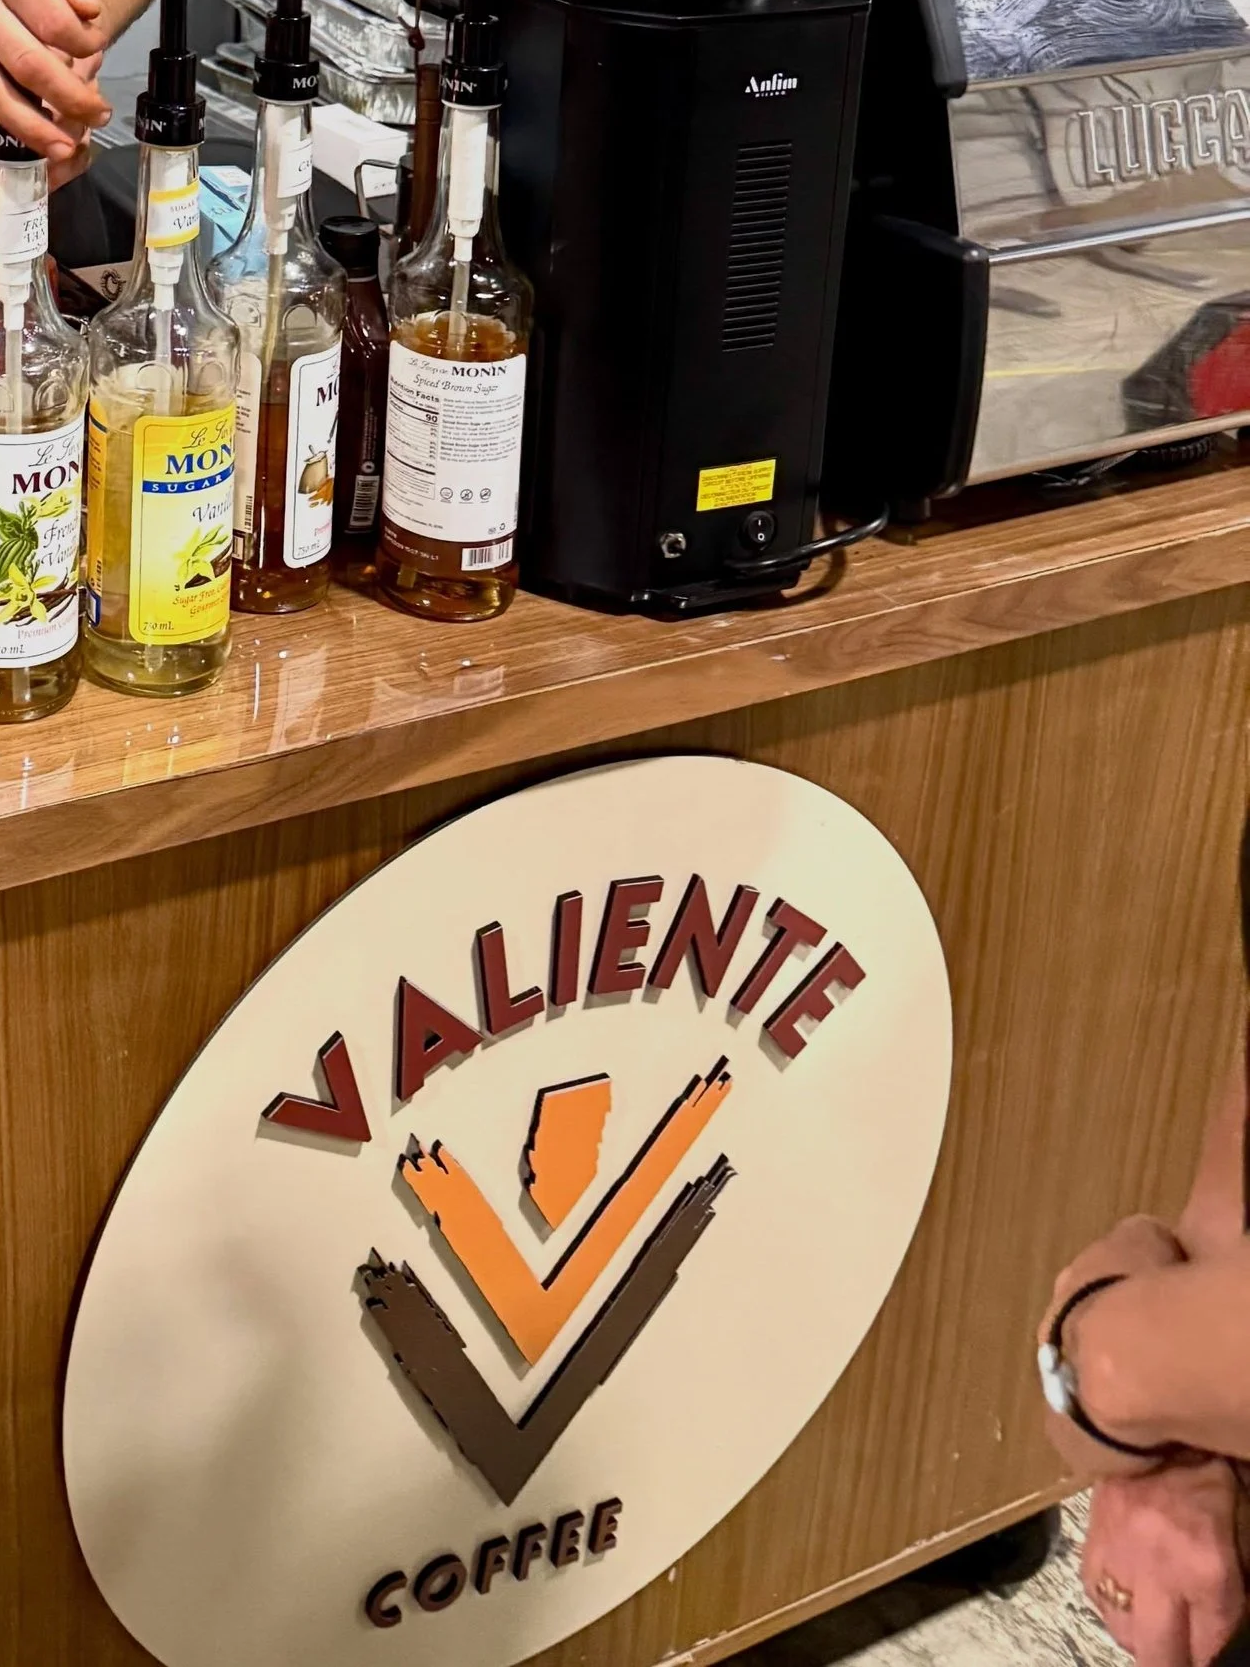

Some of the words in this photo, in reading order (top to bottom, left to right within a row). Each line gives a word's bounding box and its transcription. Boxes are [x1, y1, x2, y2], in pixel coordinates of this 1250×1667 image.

[444, 77, 477, 93] NIN
[745, 73, 798, 93] Anfim
[1080, 89, 1250, 187] LUCCA
[451, 364, 507, 377] MONIN
[413, 374, 440, 388] Spiced
[441, 380, 472, 393] Brown
[416, 389, 440, 403] Facts
[426, 413, 438, 423] 90
[182, 427, 207, 449] Le
[29, 445, 53, 467] Le
[165, 443, 234, 475] MON
[12, 460, 79, 495] MON
[152, 475, 222, 492] SUGAR
[803, 568, 854, 587] Anfim
[17, 624, 57, 640] Premium
[9, 644, 25, 655] mL
[258, 872, 867, 1143] VALIENTE
[363, 1496, 623, 1629] COFFEE
